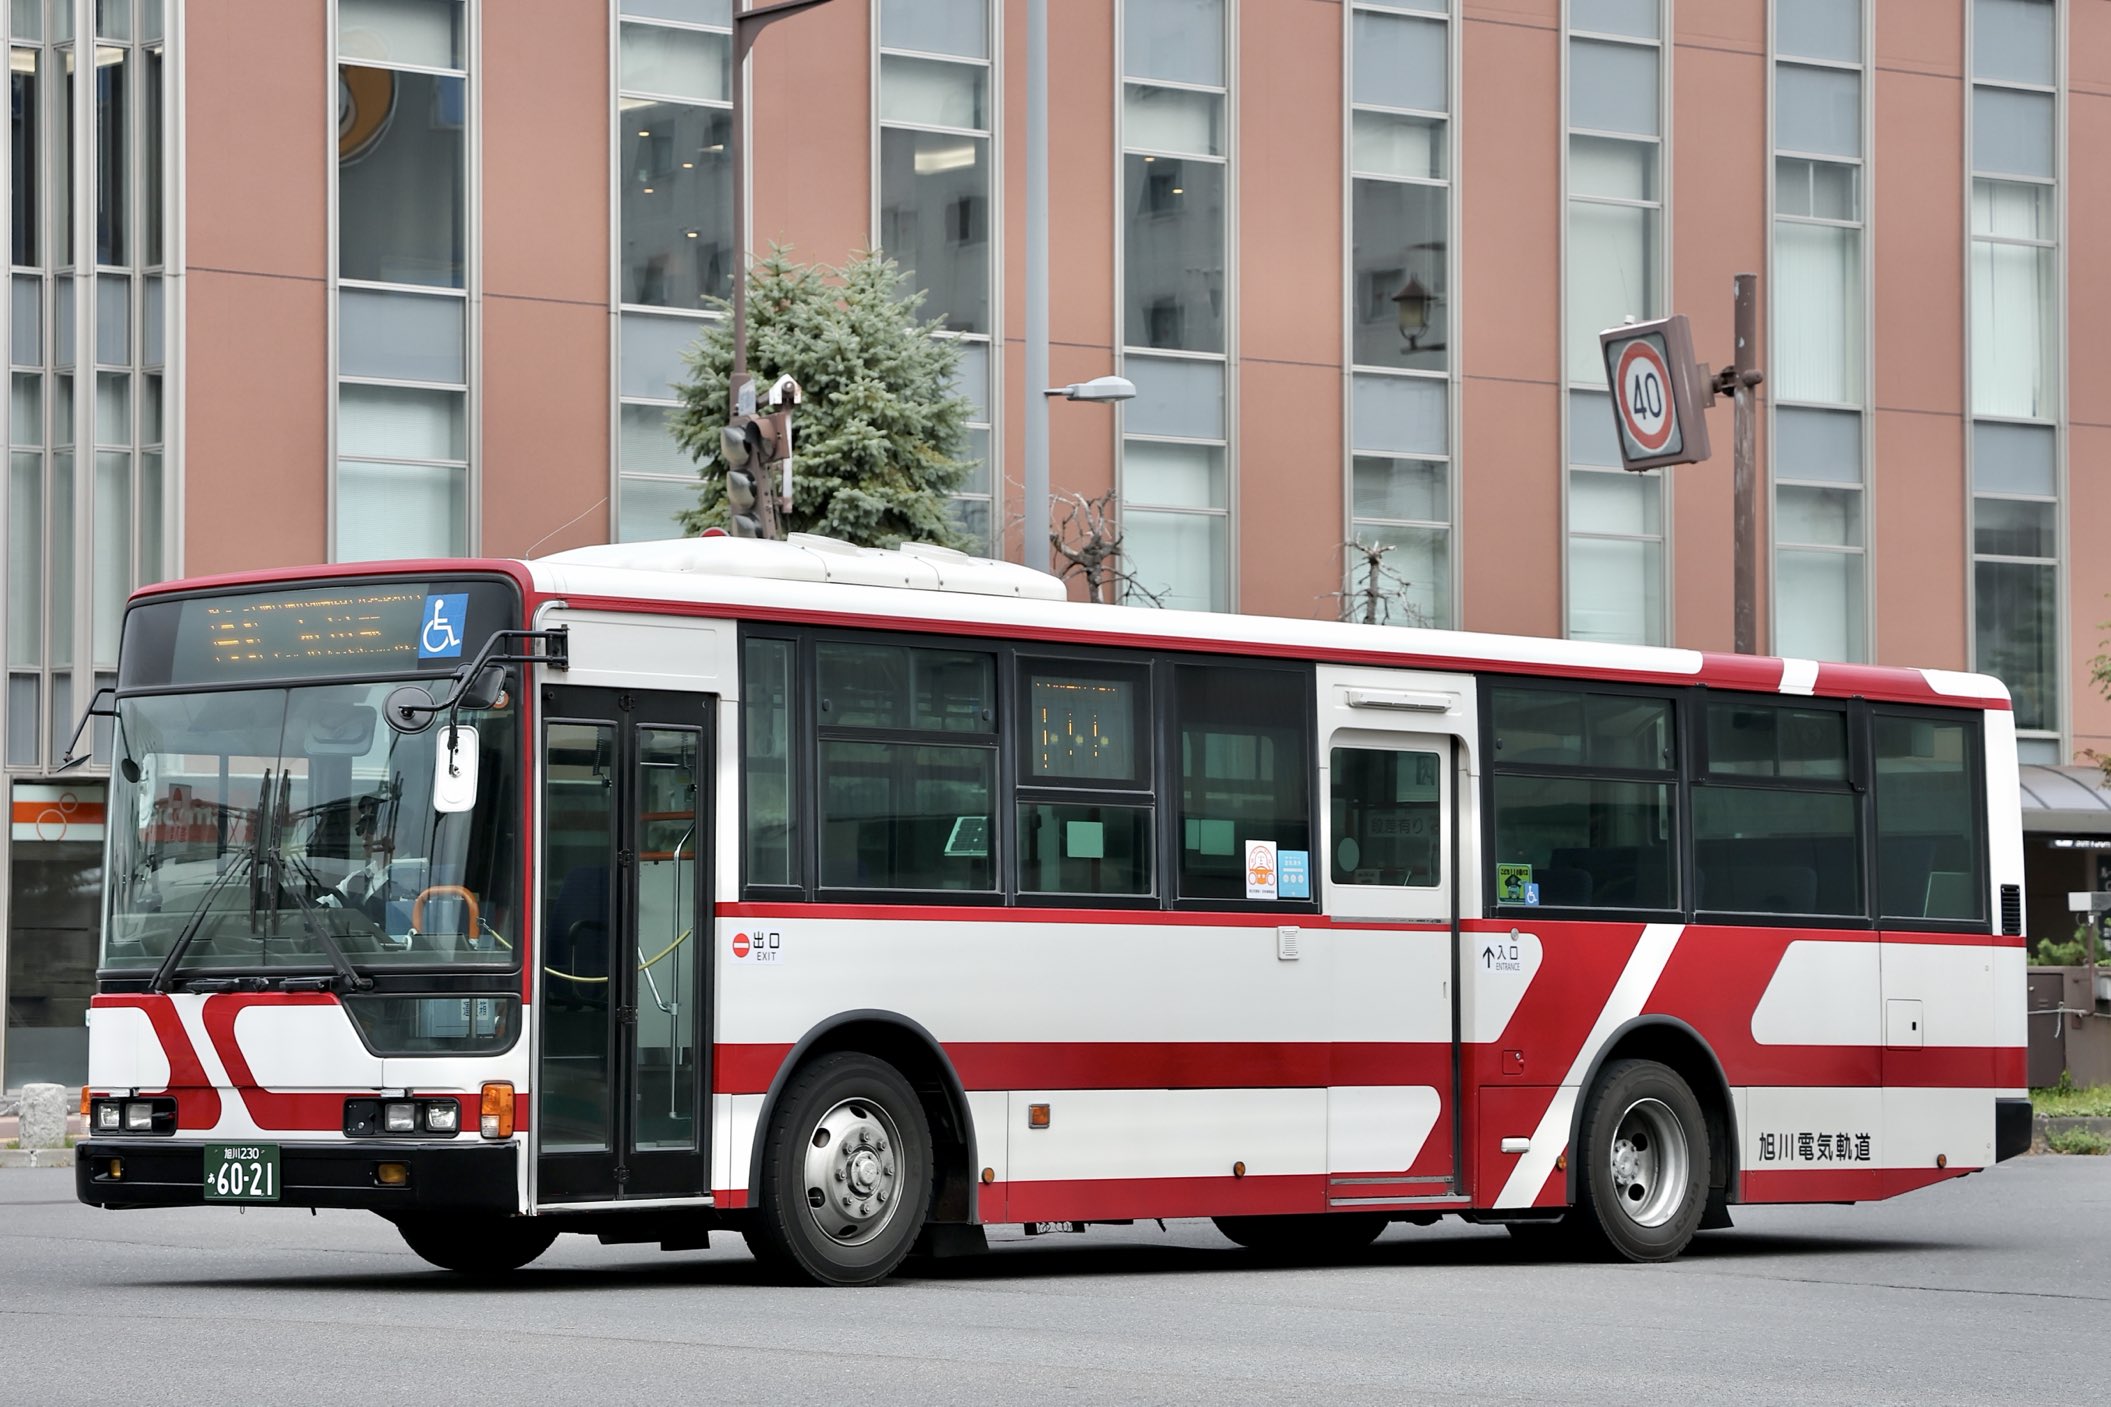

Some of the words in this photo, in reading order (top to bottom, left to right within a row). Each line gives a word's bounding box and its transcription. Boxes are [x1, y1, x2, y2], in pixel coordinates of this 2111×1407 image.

[1633, 372, 1662, 420] 40
[753, 931, 780, 949] 出口
[757, 951, 777, 961] EXIT
[1497, 945, 1519, 960] 入口
[1495, 962, 1521, 971] ENTRANCE
[1758, 1131, 1871, 1161] 旭川電気軌道
[207, 1172, 216, 1184] あ
[217, 1162, 273, 1195] 60-21
